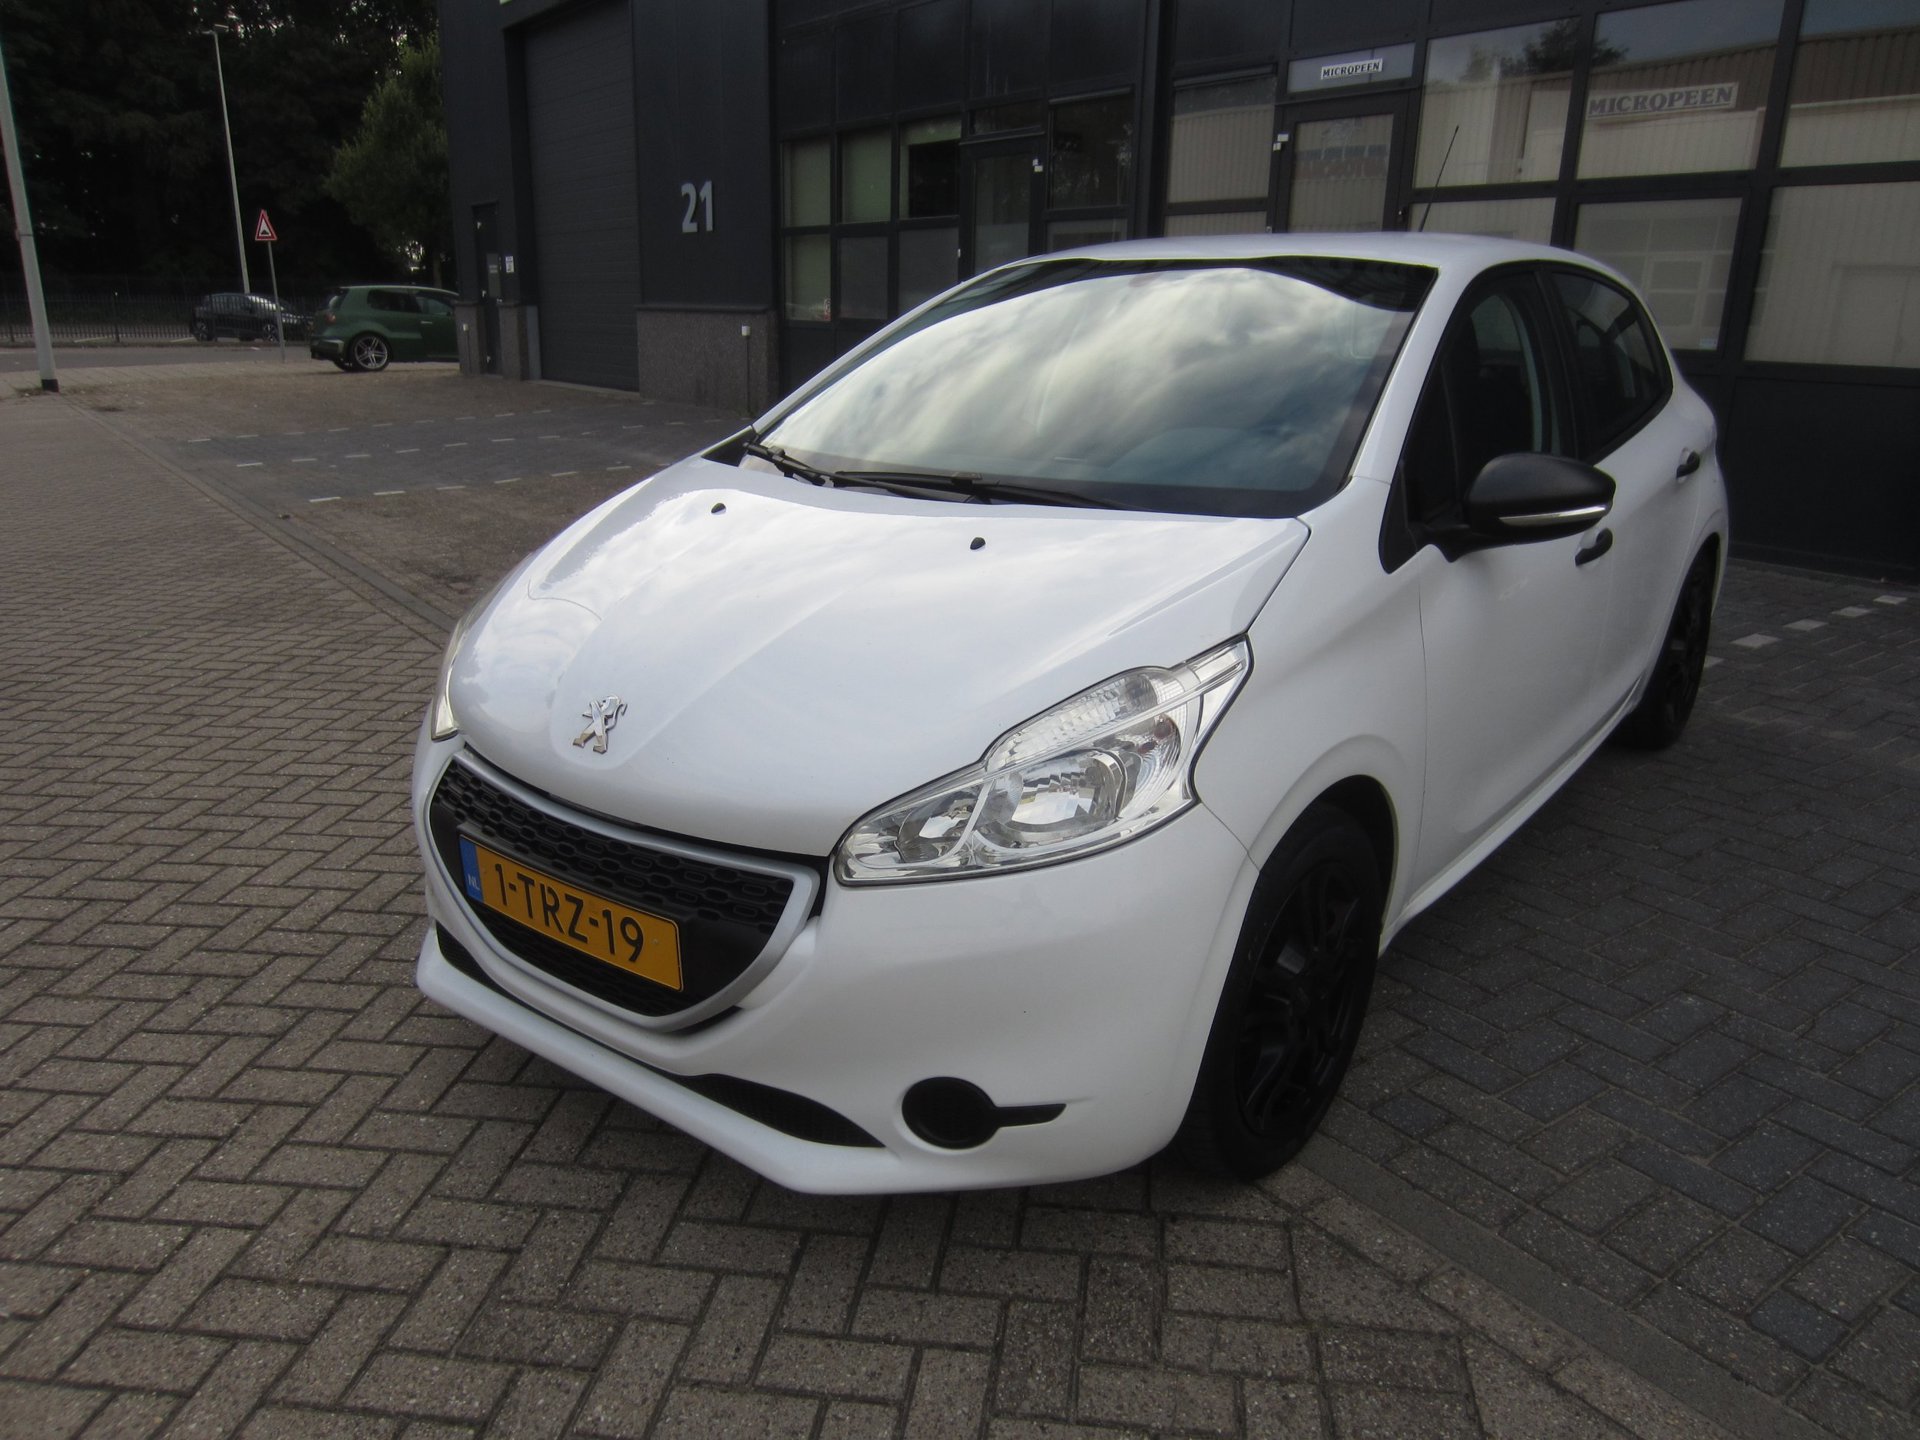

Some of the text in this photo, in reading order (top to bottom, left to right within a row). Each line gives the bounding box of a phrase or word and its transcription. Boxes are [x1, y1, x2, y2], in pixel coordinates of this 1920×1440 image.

[1322, 62, 1380, 77] MICROPEEN
[1589, 87, 1732, 115] MICROPEEN
[681, 180, 713, 233] 21
[467, 863, 644, 963] NL 1-TRZ-19
